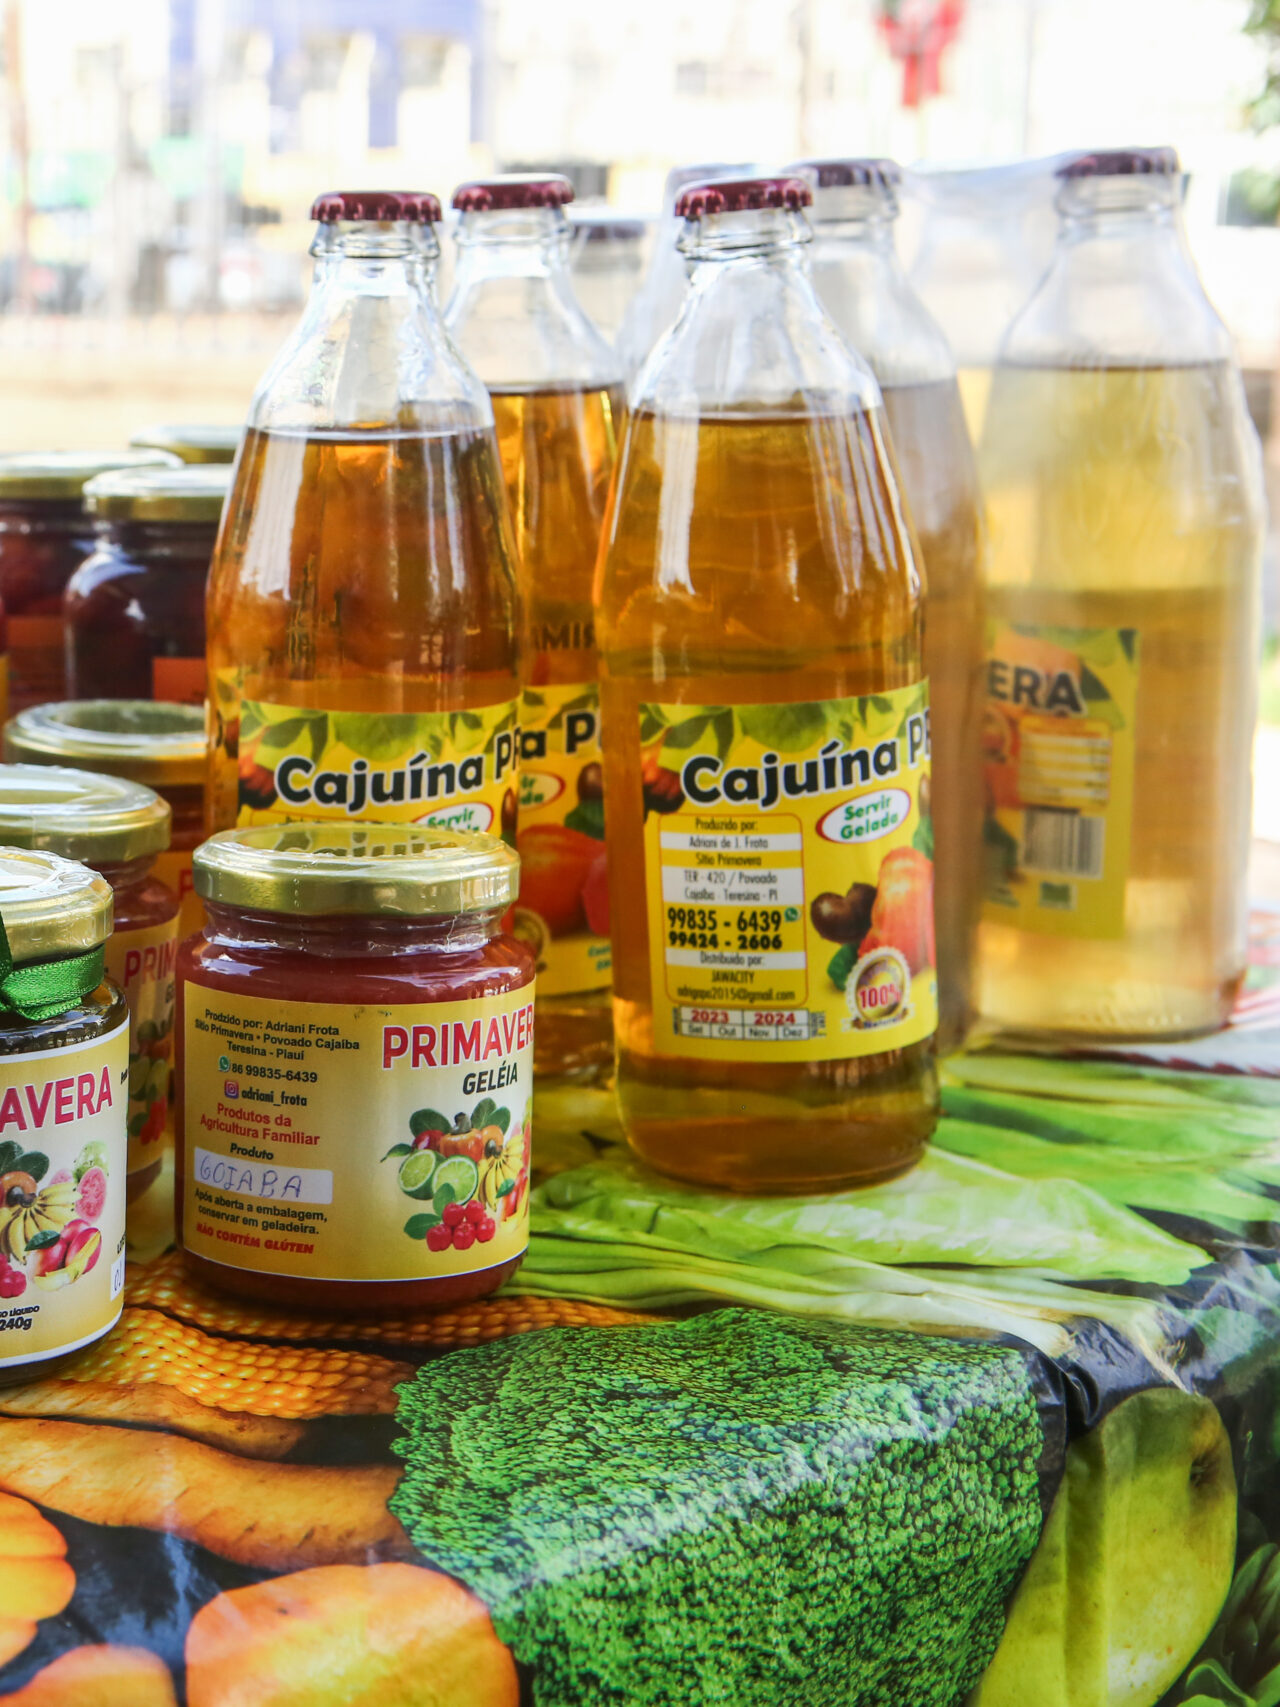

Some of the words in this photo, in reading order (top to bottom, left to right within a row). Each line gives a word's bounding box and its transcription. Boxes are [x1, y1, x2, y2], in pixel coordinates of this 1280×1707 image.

[276, 753, 483, 813] Cajuína
[681, 739, 898, 808] Cajuína
[844, 794, 891, 821] Servir
[696, 818, 738, 831] Produzido
[741, 821, 758, 833] por:
[840, 811, 899, 839] Gelado
[689, 836, 717, 848] Adriani
[721, 837, 731, 848] de
[745, 837, 768, 848] Frota
[717, 853, 762, 866] Primavera
[739, 871, 778, 884] Povoado
[723, 888, 760, 901] Teresina
[668, 908, 717, 930] 99835
[737, 910, 782, 932] 6439
[669, 931, 719, 949] 99424
[738, 934, 783, 950] 2606
[243, 1018, 263, 1031] por:
[265, 1020, 305, 1034] Adriani
[308, 1024, 340, 1036] Frota
[691, 1009, 730, 1024] 2023
[753, 1012, 796, 1026] 2024
[210, 1023, 254, 1042] Primavera
[263, 1034, 312, 1048] Povoado
[382, 1003, 534, 1069] PRIMAVER
[718, 1025, 736, 1036] Out
[749, 1027, 769, 1037] Nov
[783, 1027, 802, 1038] Dez
[227, 1040, 267, 1057] Teresina
[276, 1048, 305, 1061] Piauí
[231, 1063, 243, 1074] 86
[245, 1065, 318, 1083] 99835-6439
[462, 1060, 518, 1095] GELÉIA
[241, 1087, 308, 1106] adriani_frota
[217, 1102, 271, 1124] Produtos
[275, 1114, 292, 1127] da
[200, 1114, 259, 1139] Agricultura
[263, 1128, 320, 1146] Familiar
[230, 1143, 274, 1160] Produto
[195, 1188, 212, 1203] Após
[214, 1195, 245, 1211] aberta
[247, 1203, 254, 1212] a
[256, 1205, 328, 1223] embalagem,
[198, 1205, 240, 1223] conservar
[242, 1216, 258, 1227] em
[261, 1219, 320, 1235] geladeira.
[196, 1221, 214, 1237] NÃO
[216, 1229, 261, 1248] CONTÉM
[264, 1238, 315, 1255] GLÚTEN
[9, 1304, 40, 1318] LÍQUIDO
